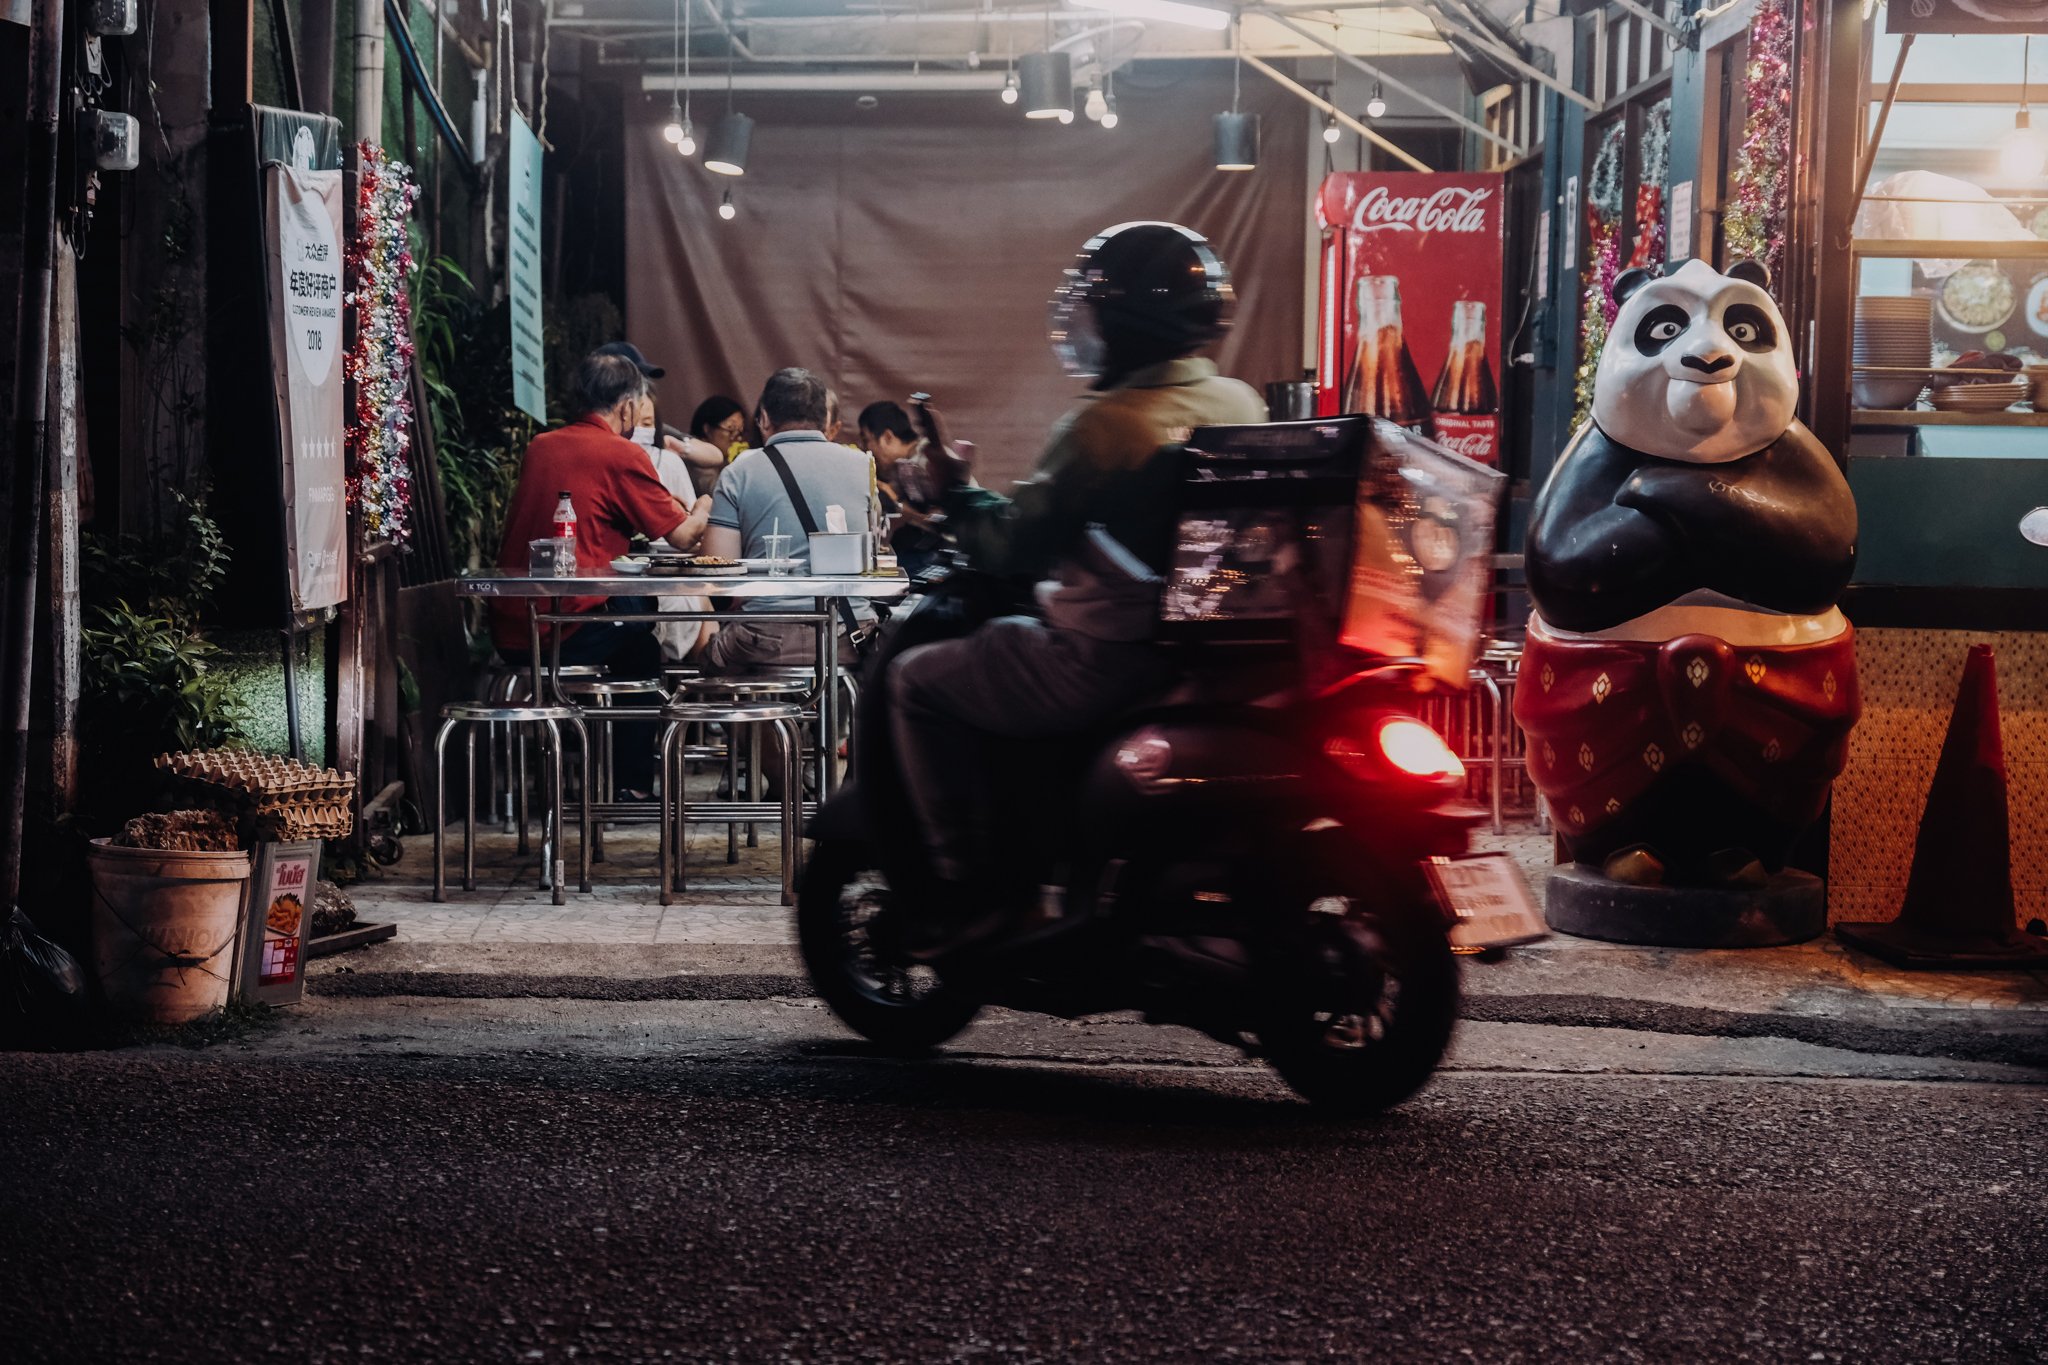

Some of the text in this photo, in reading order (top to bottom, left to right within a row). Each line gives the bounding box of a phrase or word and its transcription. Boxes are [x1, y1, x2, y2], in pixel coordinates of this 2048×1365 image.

[1354, 186, 1493, 232] Coca-Cola
[305, 242, 328, 262] 大众点评
[290, 269, 336, 299] 年度好评商户
[307, 329, 322, 350] 2018
[1435, 417, 1495, 429] ORIGINAL TASTE
